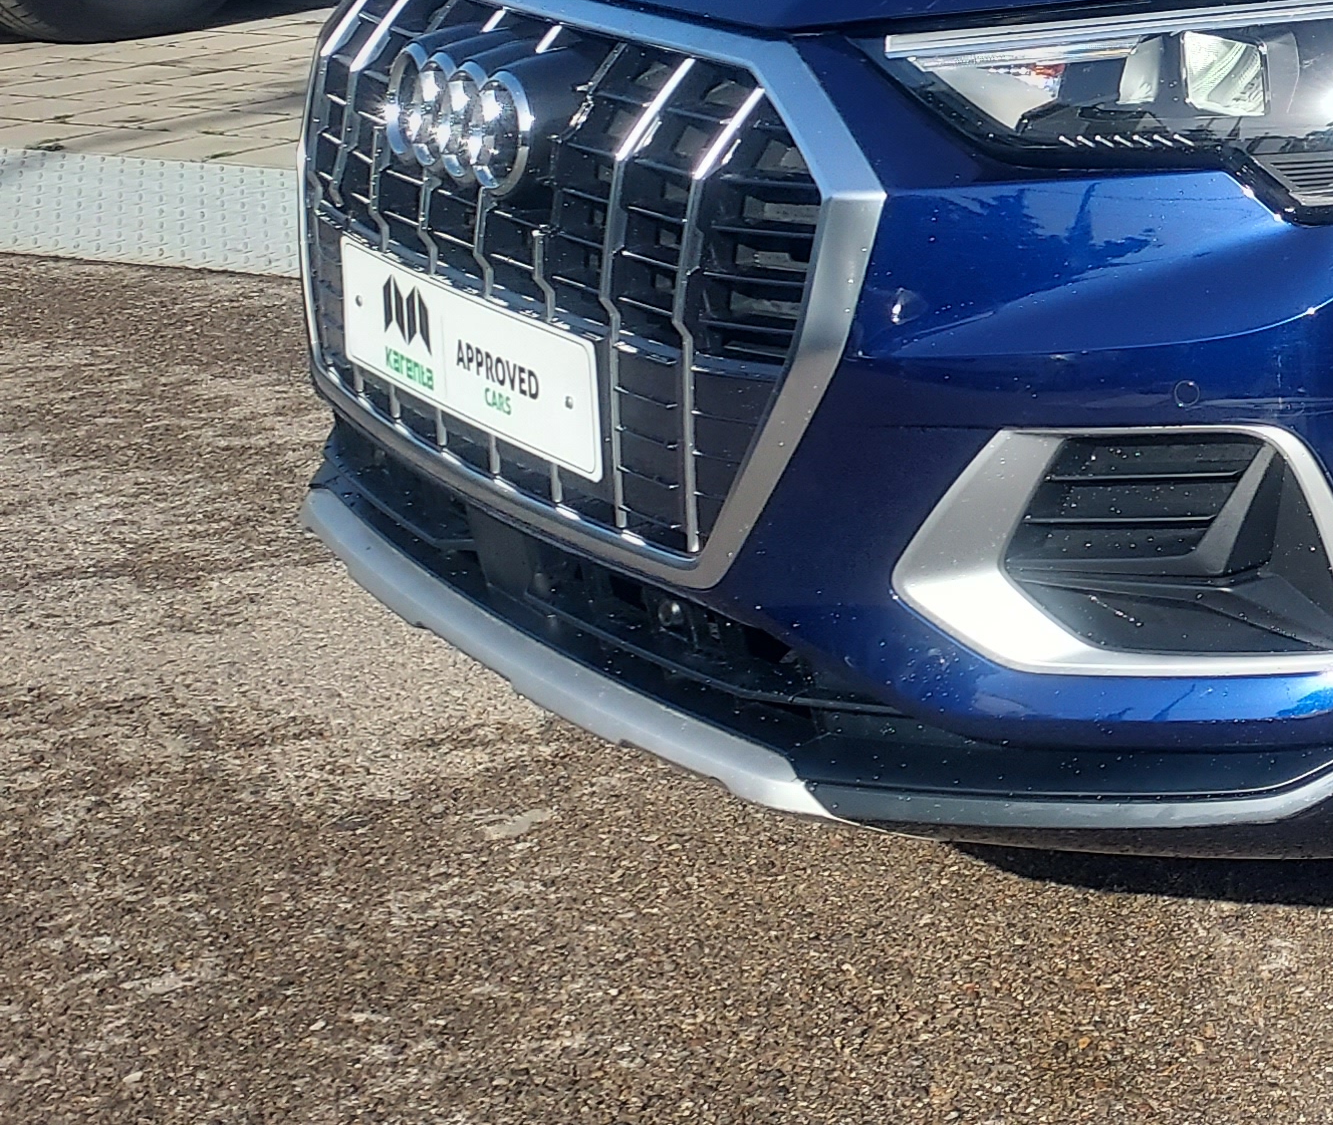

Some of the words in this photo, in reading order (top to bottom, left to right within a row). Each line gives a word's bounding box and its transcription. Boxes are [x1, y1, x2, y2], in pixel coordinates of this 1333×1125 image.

[384, 345, 435, 392] karenta
[456, 339, 540, 400] APPROVED
[484, 387, 513, 416] CARS
